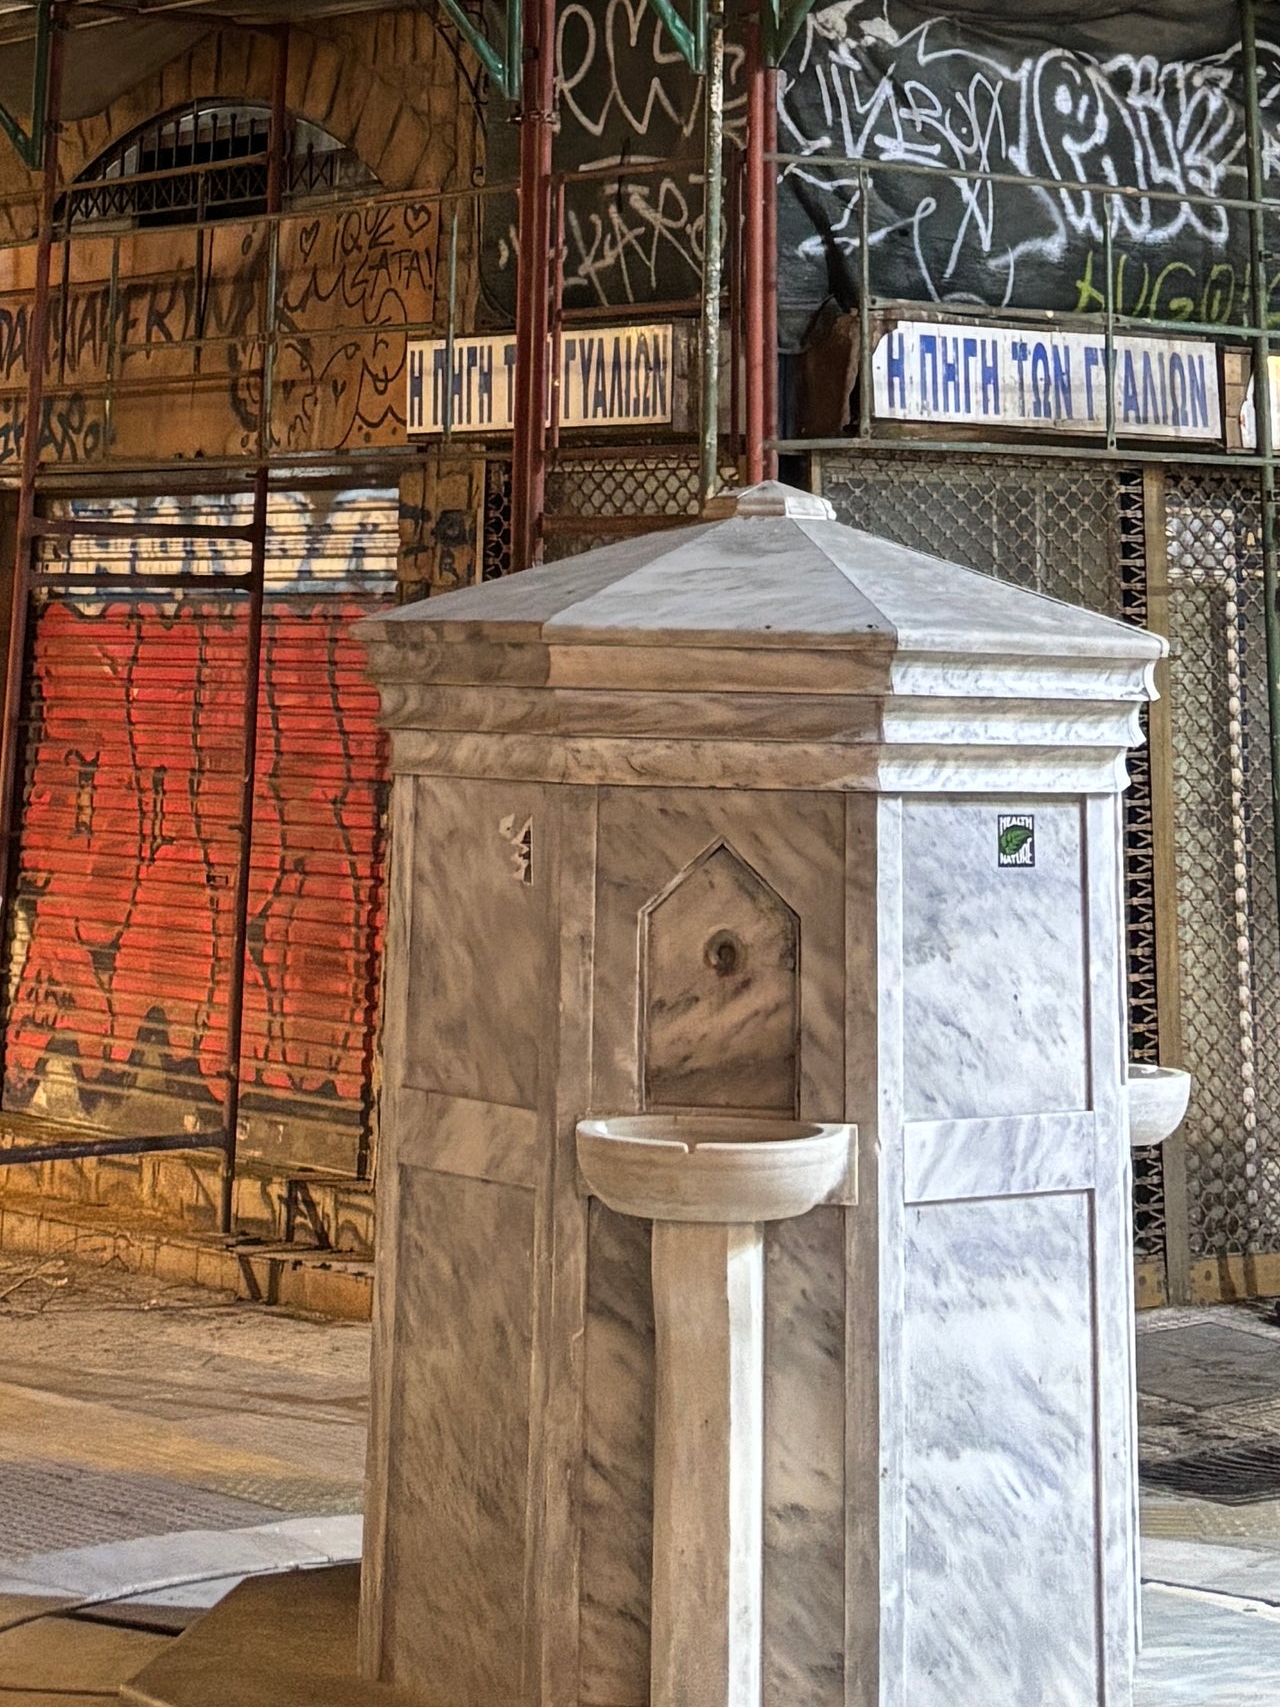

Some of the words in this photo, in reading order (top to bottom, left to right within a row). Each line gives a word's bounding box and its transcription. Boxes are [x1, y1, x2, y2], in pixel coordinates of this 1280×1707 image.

[410, 350, 423, 427] Η
[433, 345, 493, 426] ΠΗΓΗ
[564, 333, 667, 419] ΓΥΑΛΙΩΝ
[887, 333, 906, 409] Η
[920, 334, 1000, 415] ΠΗΓΗ
[1011, 341, 1073, 420] ΤΩΝ
[1000, 837, 1033, 865] NATURE
